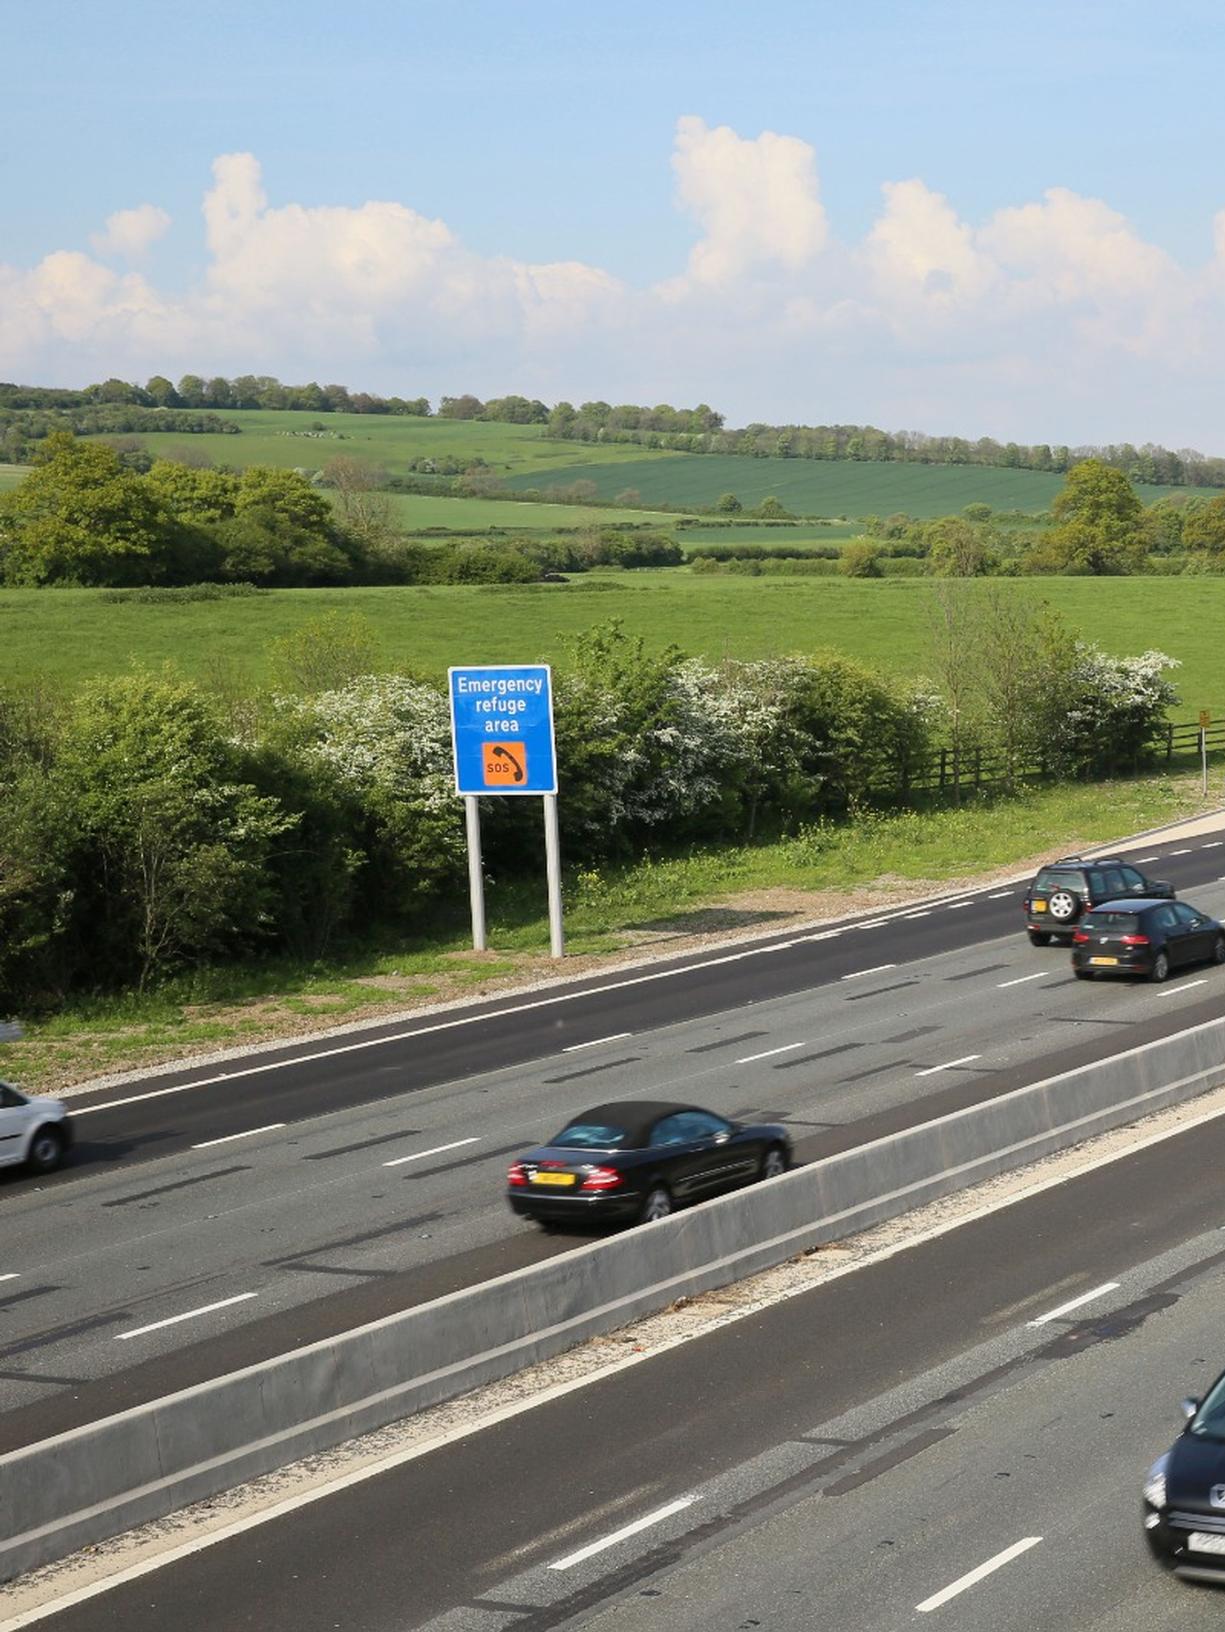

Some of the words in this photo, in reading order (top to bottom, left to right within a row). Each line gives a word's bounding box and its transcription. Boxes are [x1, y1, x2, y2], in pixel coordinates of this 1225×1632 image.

[458, 677, 542, 694] Emergency
[475, 696, 526, 714] refuge
[484, 719, 519, 732] area
[487, 763, 510, 773] SOS
